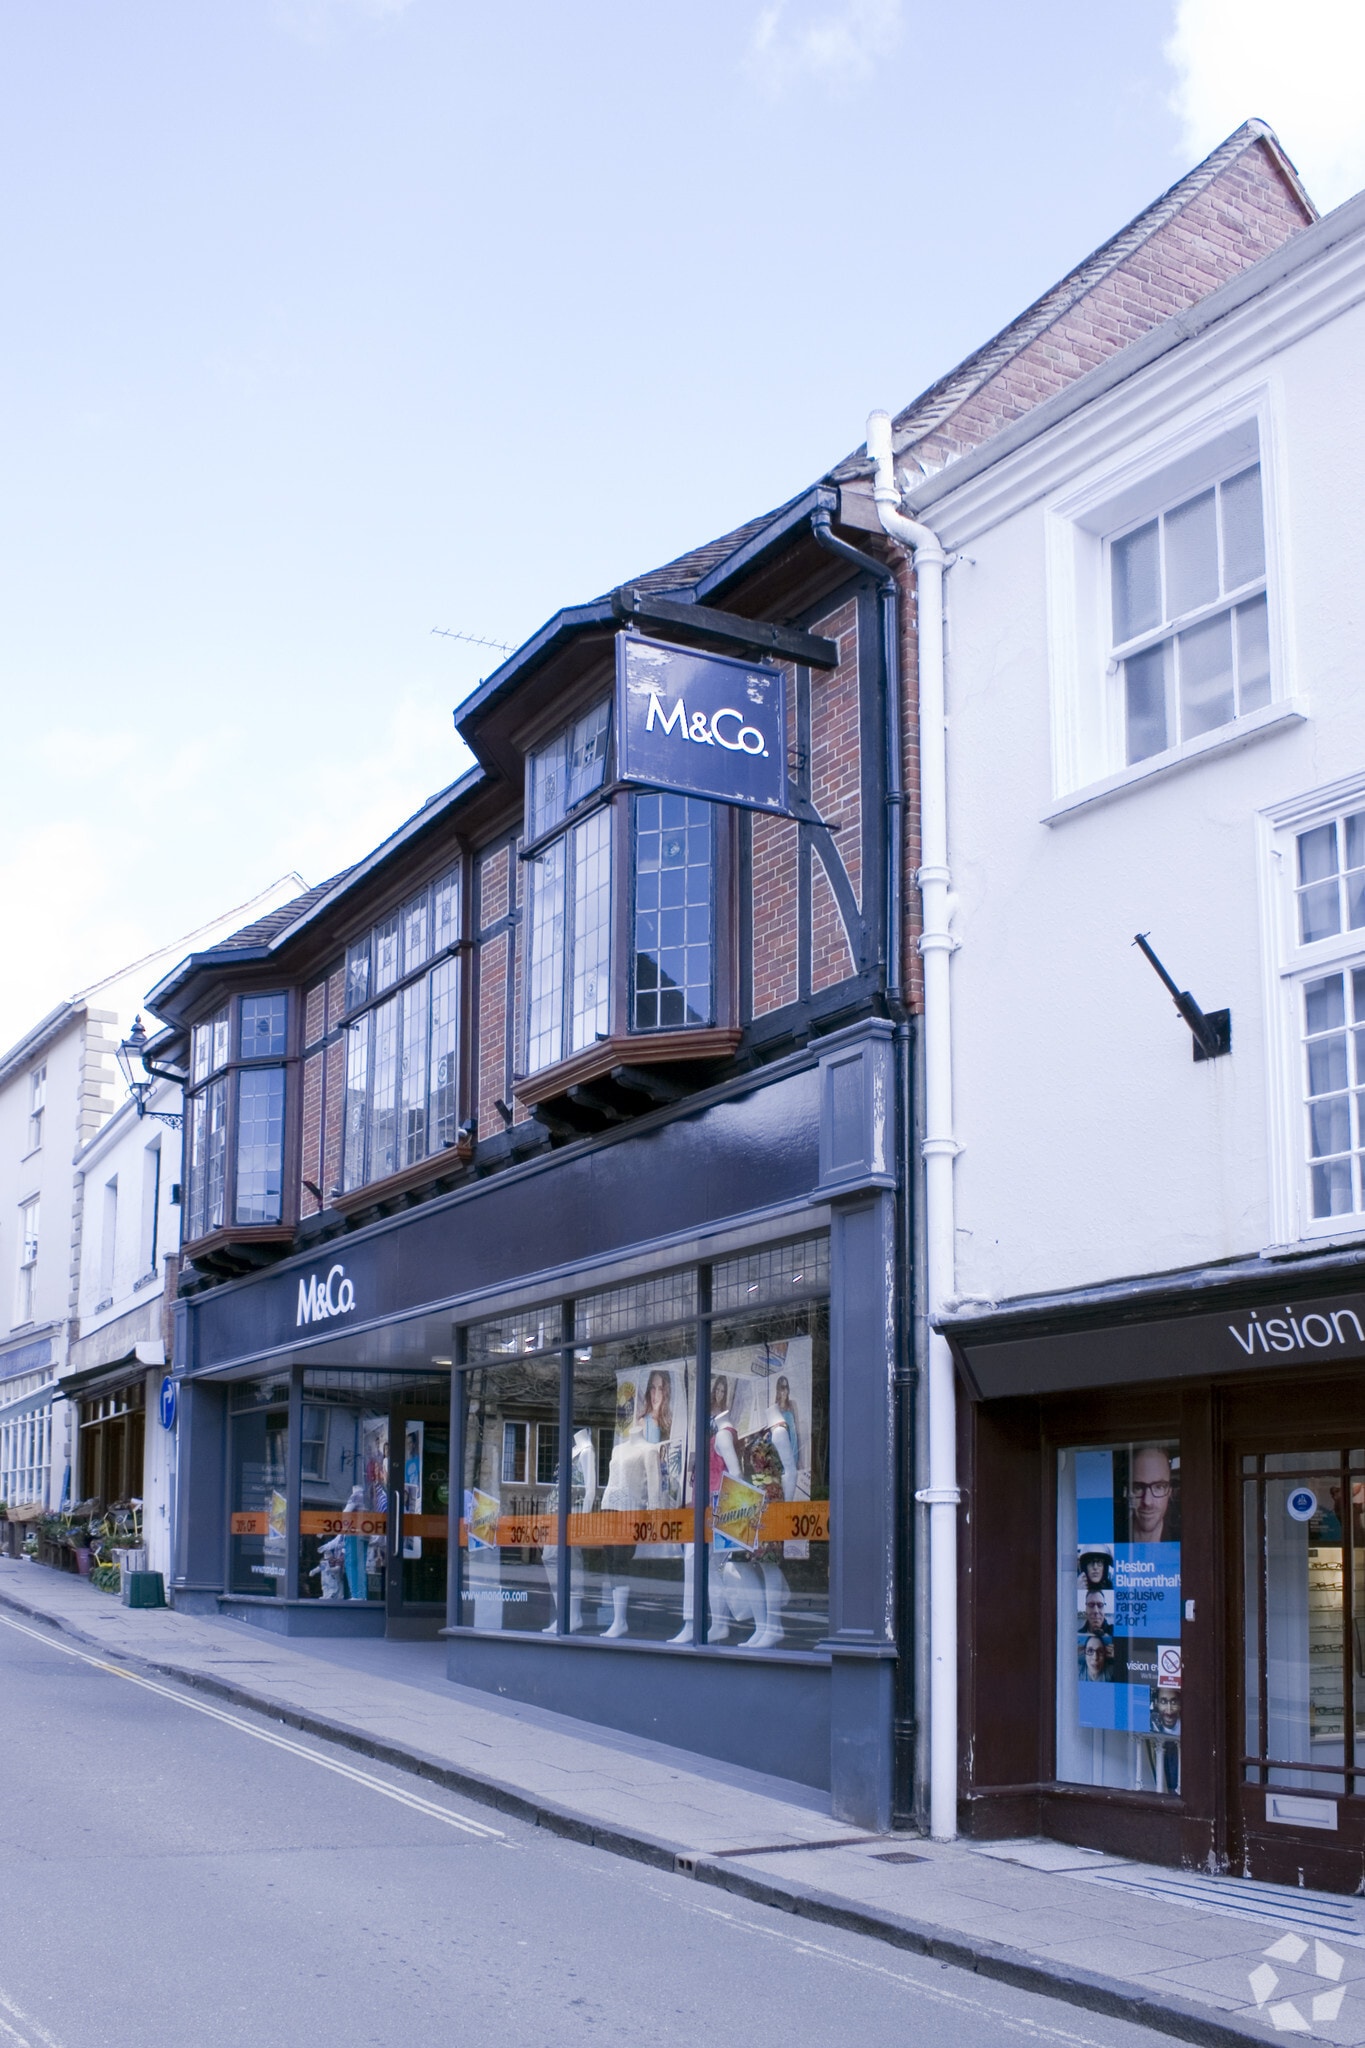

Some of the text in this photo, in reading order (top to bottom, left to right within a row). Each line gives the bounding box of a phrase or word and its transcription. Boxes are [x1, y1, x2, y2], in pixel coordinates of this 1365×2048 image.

[645, 692, 769, 758] M&Co.
[296, 1264, 356, 1326] M&Co.
[1228, 1306, 1365, 1356] vision
[247, 1519, 257, 1533] OFF
[323, 1519, 356, 1534] 30%
[633, 1521, 683, 1542] 30% OFF
[791, 1513, 823, 1538] 30%
[510, 1525, 550, 1543] 30% OFF
[1115, 1560, 1155, 1573] Heston
[460, 1586, 528, 1602] www.mandco.com
[1115, 1589, 1165, 1601] exclusive
[1115, 1602, 1148, 1615] range
[1115, 1614, 1148, 1626] 2 for 1
[1126, 1660, 1149, 1671] vision
